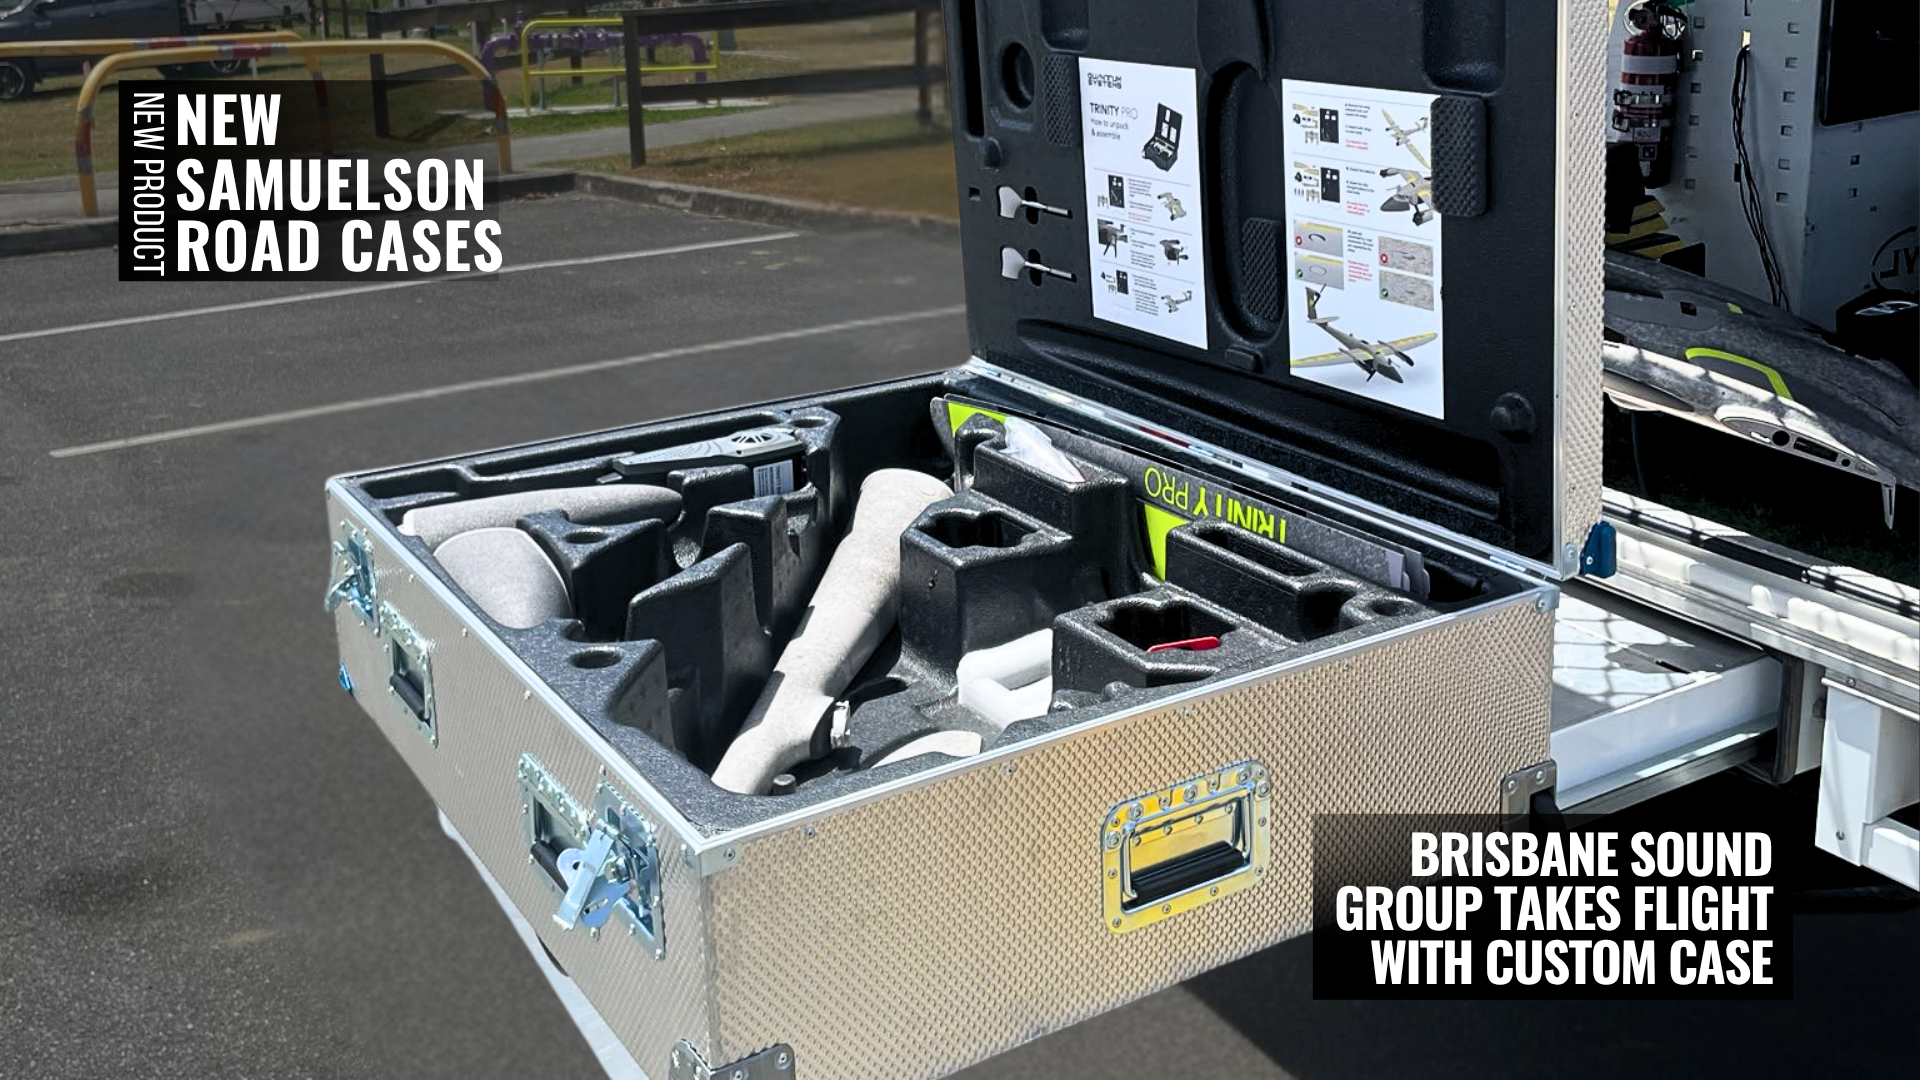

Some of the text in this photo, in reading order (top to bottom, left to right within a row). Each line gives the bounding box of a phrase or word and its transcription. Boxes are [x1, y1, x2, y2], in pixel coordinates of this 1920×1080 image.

[1090, 102, 1139, 120] TRINITY PRO
[1103, 119, 1109, 127] to
[1145, 467, 1189, 510] PRO
